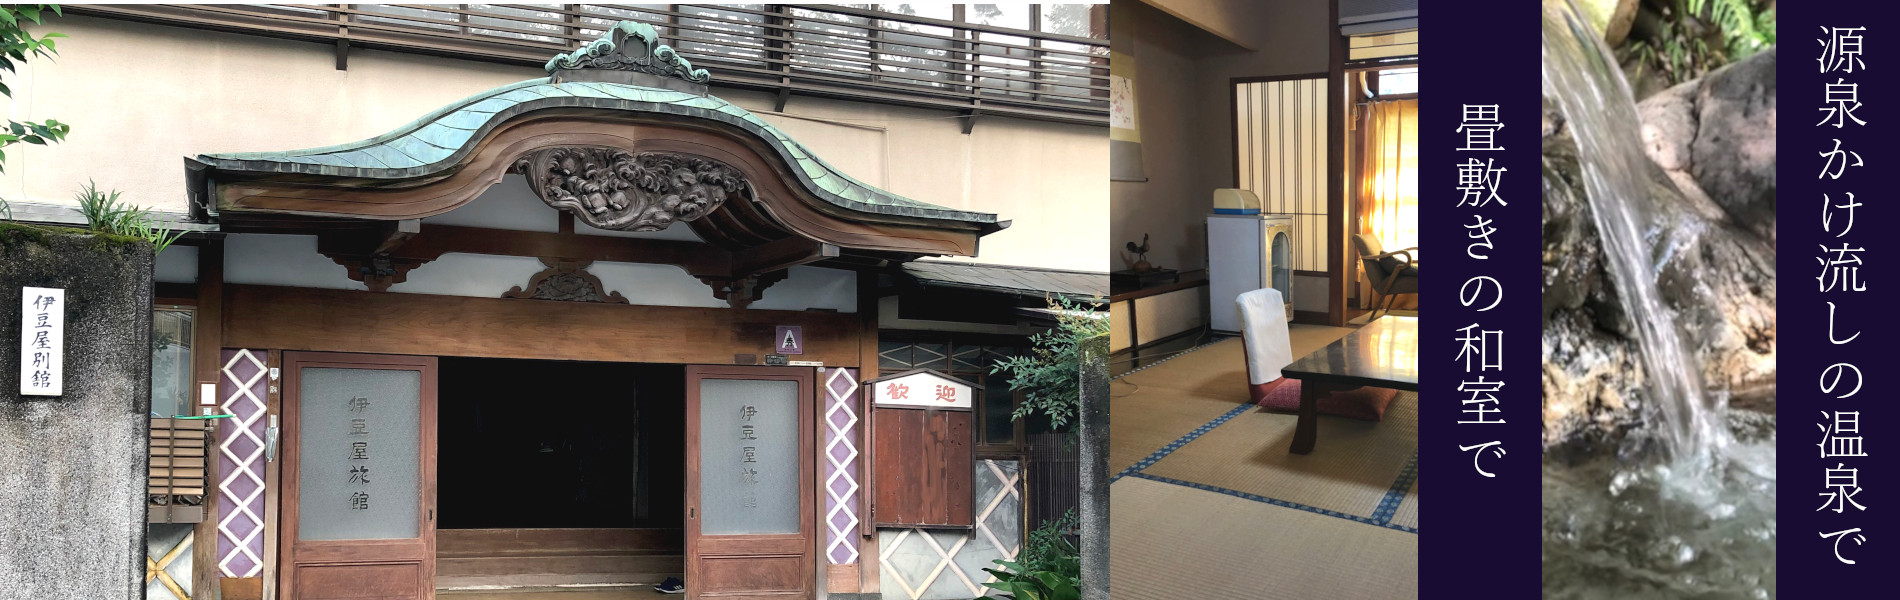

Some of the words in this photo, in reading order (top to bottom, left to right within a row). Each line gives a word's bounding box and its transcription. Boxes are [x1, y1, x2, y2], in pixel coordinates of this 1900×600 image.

[886, 382, 956, 403] 歓迎
[347, 395, 371, 511] 伊豆屋旅館
